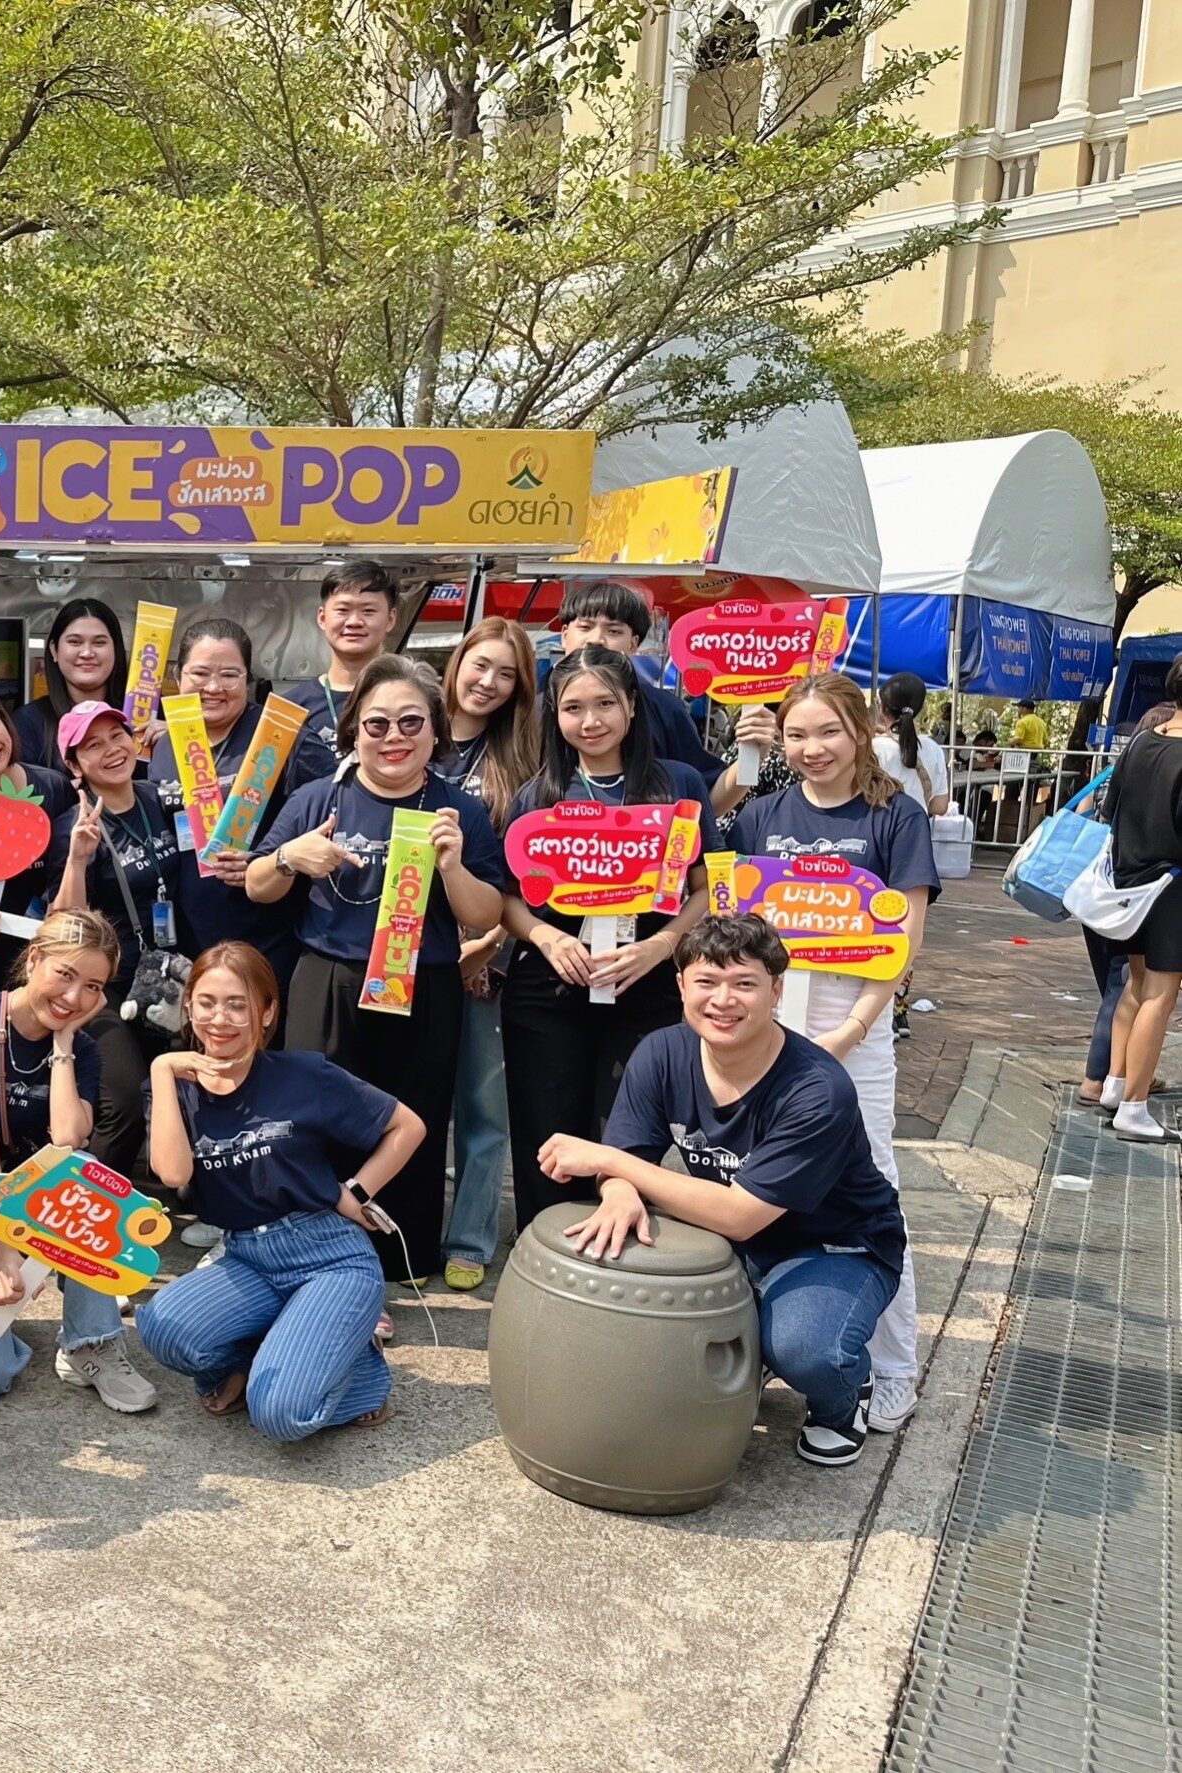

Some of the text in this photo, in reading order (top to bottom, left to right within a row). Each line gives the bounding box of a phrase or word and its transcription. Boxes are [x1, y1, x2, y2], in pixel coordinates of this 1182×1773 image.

[196, 456, 255, 480] มะม่วง
[15, 439, 460, 526] ICE POP
[177, 479, 266, 504] ฮักเสาวรส
[468, 493, 573, 526] ดอยคำ
[690, 628, 812, 653] สตรอว์เบอร์รี
[1073, 628, 1090, 643] POWER
[139, 643, 160, 682] POP
[725, 649, 777, 672] ทูนหัว
[1073, 648, 1091, 662] POWER
[187, 741, 214, 787] POP
[250, 745, 277, 790] POP
[155, 846, 177, 860] ham
[528, 832, 662, 860] สตรอว์เบอร์รี
[567, 855, 624, 880] ทูนหัว
[395, 864, 423, 916] POP
[782, 882, 852, 908] มะม่วง
[383, 931, 413, 975] ICE
[203, 1145, 272, 1170] Doi Kham
[87, 1164, 128, 1194] ไอซ์ป๊อป
[59, 1183, 112, 1222] บ๊วย
[36, 1195, 109, 1252] ไม่บ๊วย
